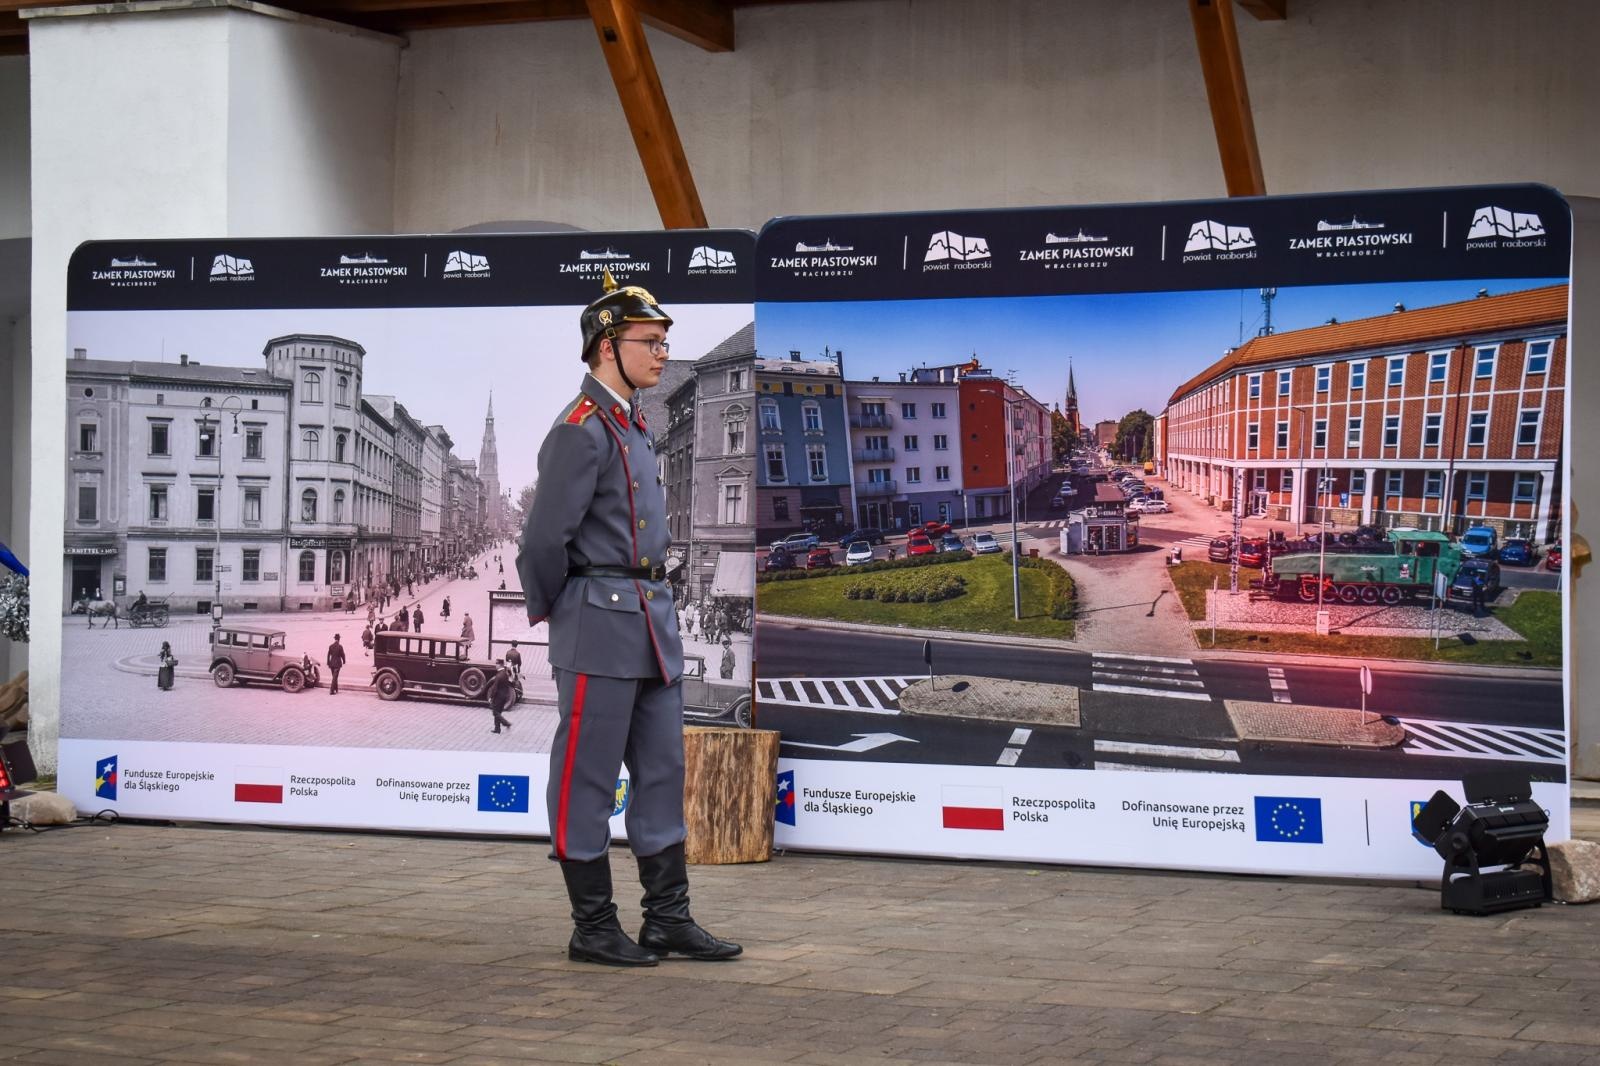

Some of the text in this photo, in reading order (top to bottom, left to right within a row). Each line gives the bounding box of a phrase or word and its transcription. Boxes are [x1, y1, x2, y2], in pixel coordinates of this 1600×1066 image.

[1289, 233, 1412, 249] ZAMEK PIASTOWSKI
[1466, 239, 1546, 251] powiat raciborski
[1019, 246, 1134, 261] ZAMEK PIASTOWSKI
[1183, 250, 1257, 263] powiat raciborski
[559, 263, 592, 273] ZAMEK
[771, 256, 877, 268] ZAMEK PIASTOWSKI
[923, 261, 992, 272] powiat raciborski
[92, 269, 175, 280] ZAMEK PIASTOWSKI
[320, 267, 407, 277] ZAMEK PIASTOWSKI
[124, 769, 215, 781] Fundusze Europejskie
[290, 775, 356, 787] Rzeczpospolita
[124, 778, 180, 792] dla Śląskiego
[376, 778, 470, 791] Dofinansowane przez
[290, 787, 318, 797] Polska
[399, 791, 470, 804] Unię Europejską
[803, 788, 916, 803] Fundusze Europejskie
[804, 799, 873, 816] dla Śląskiego
[1012, 796, 1096, 810] Rzeczpospolita
[1122, 800, 1245, 816] Dofinansowane przez
[1013, 811, 1049, 823] Polska
[1152, 816, 1246, 832] Unię Europejską
